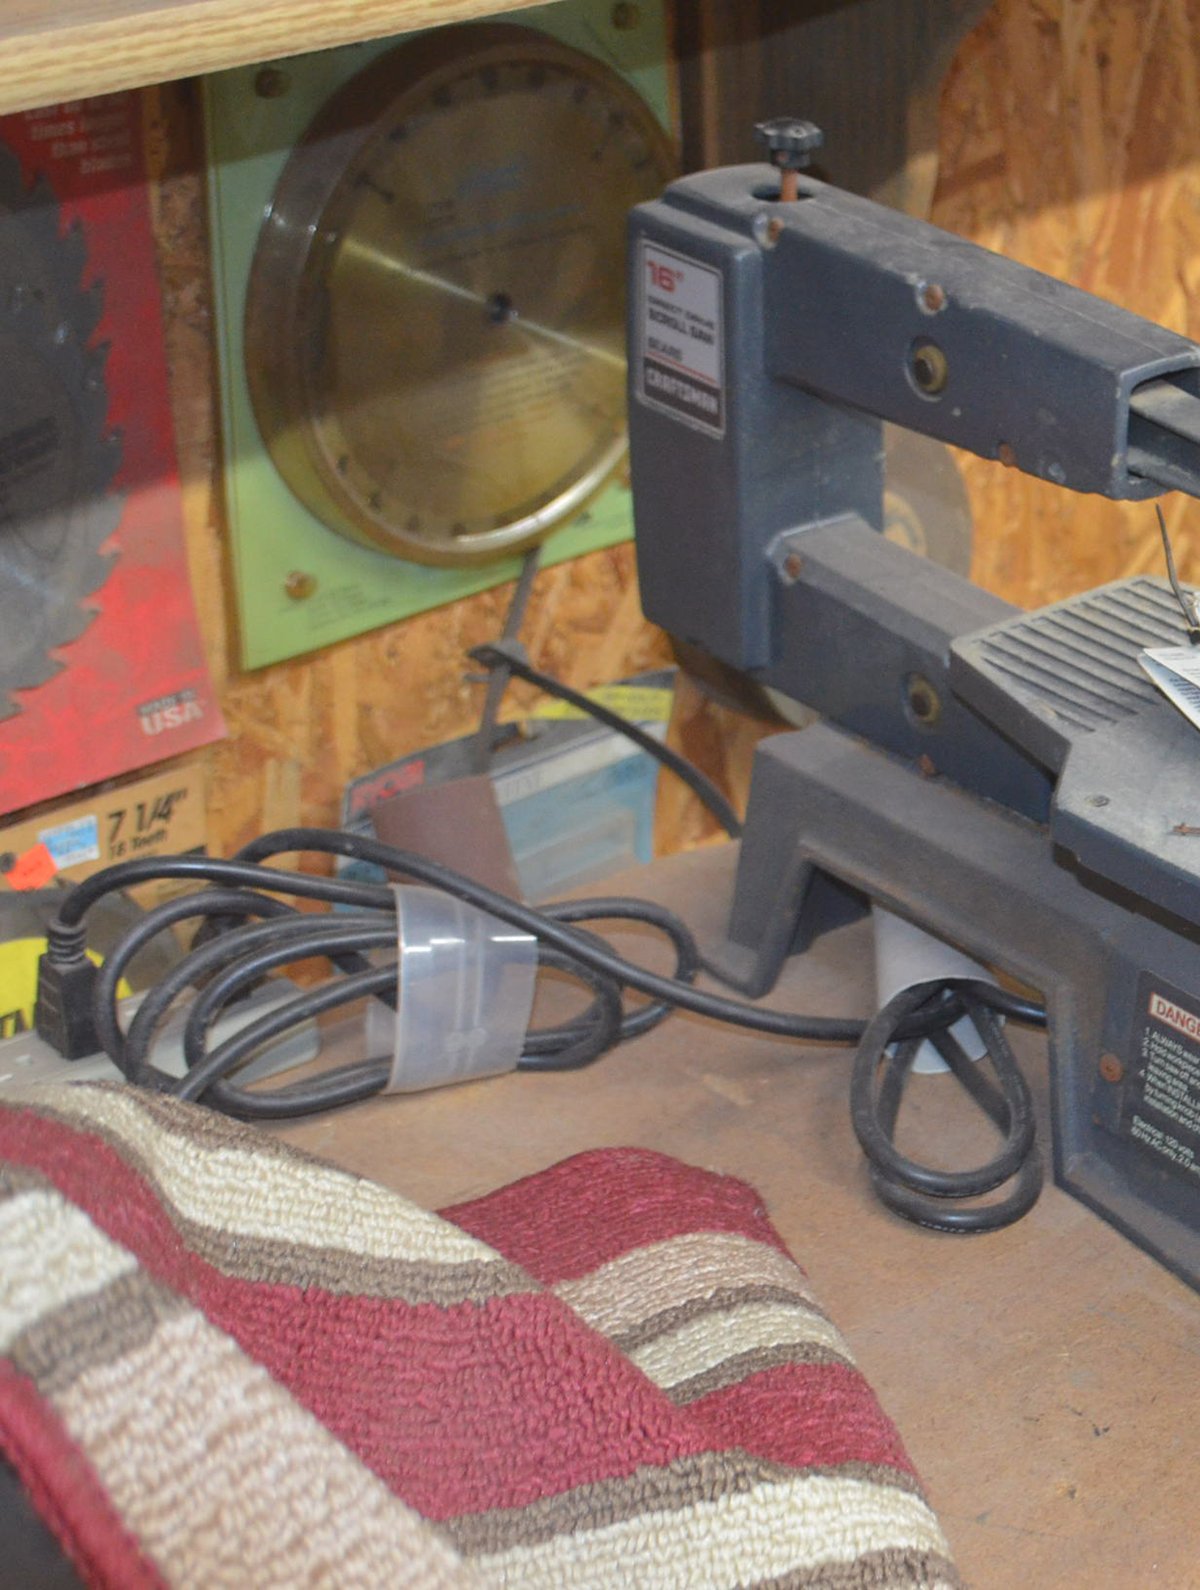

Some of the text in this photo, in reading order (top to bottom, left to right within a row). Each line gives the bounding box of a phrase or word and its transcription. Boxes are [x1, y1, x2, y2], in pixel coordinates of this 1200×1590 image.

[648, 308, 715, 345] SCROLL SAW
[646, 367, 719, 414] CRAFTSMAN
[141, 702, 204, 737] USA
[108, 809, 127, 843] 7
[1152, 1030, 1183, 1055] ALWAYS
